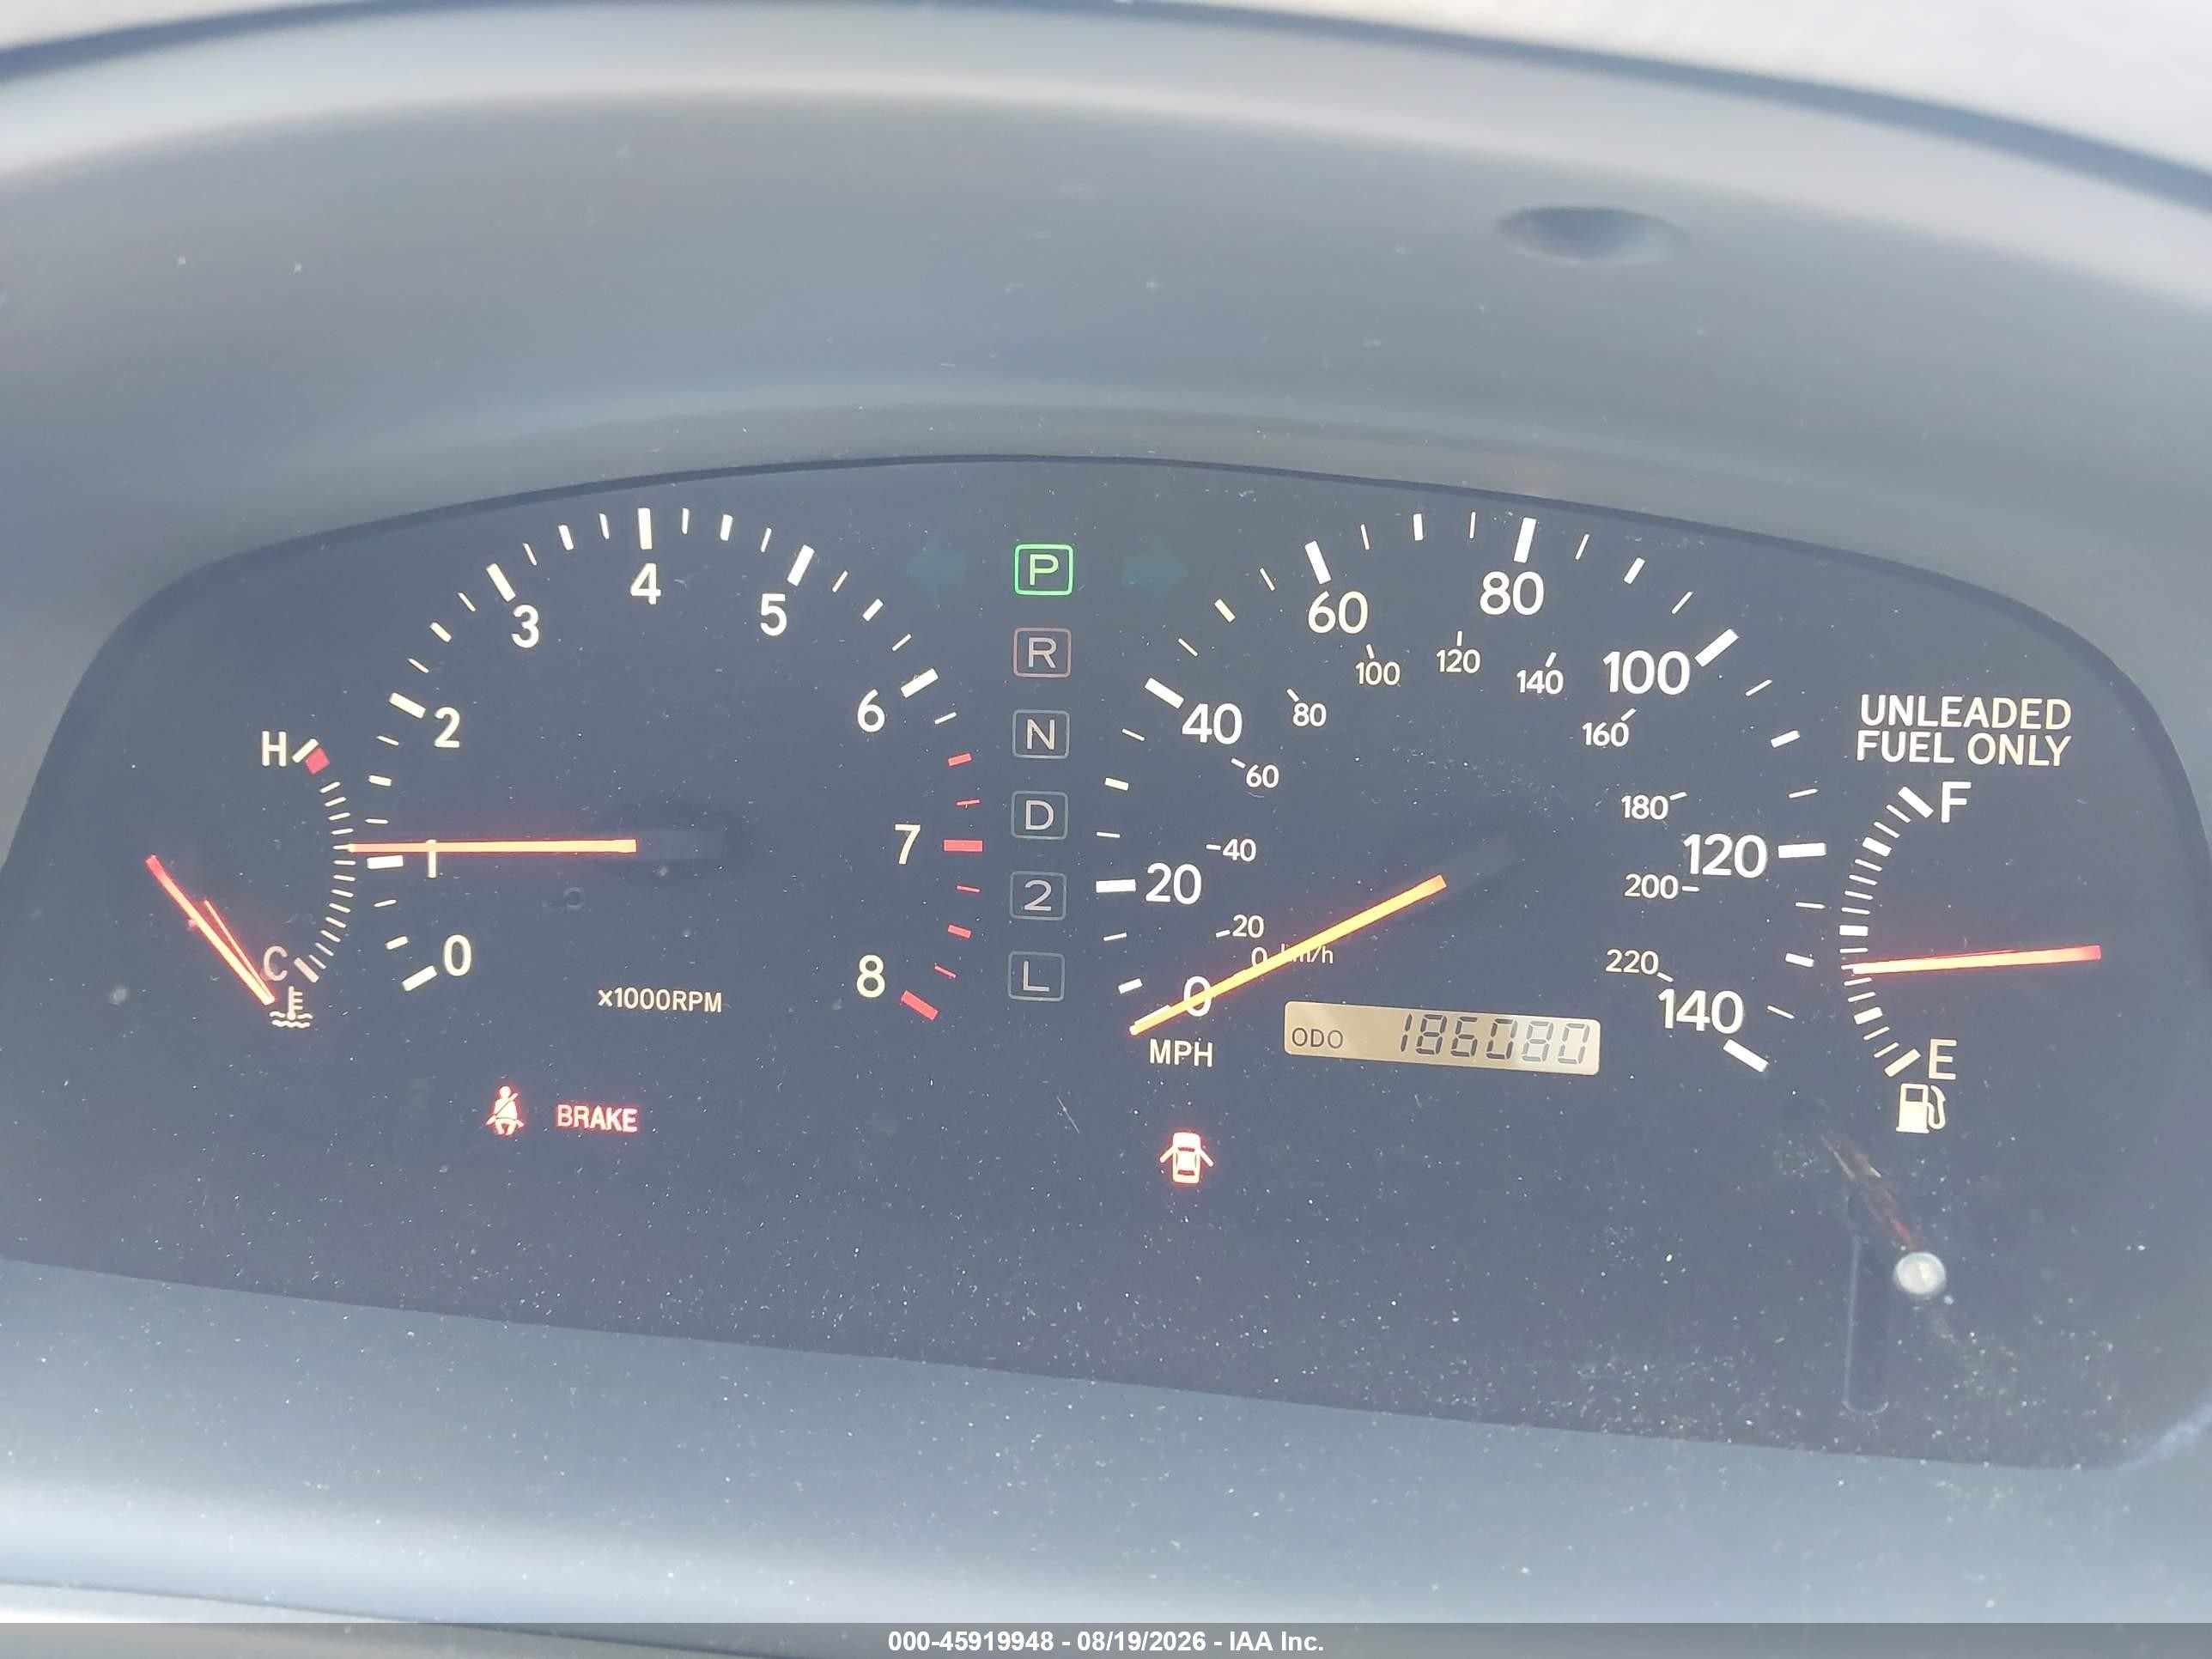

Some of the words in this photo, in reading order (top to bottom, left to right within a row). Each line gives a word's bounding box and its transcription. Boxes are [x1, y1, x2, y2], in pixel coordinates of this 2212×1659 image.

[630, 563, 661, 605] 4
[1029, 554, 1059, 586] P
[1480, 571, 1544, 615] 80
[512, 605, 538, 647] 3
[761, 593, 787, 635] 5
[1308, 591, 1369, 634] 60
[1028, 637, 1056, 668] R
[1437, 649, 1480, 673] 120
[1356, 661, 1401, 685] 100
[1516, 670, 1564, 694] 140
[1603, 650, 1690, 696] 100
[434, 707, 459, 748] 2
[858, 690, 887, 732] 6
[1182, 703, 1243, 744] 40
[1292, 702, 1327, 726] 80
[1862, 694, 2071, 730] UNLEADED
[262, 731, 286, 767] H
[1026, 720, 1055, 750] N
[1583, 723, 1629, 747] 160
[1857, 730, 1954, 763] FUEL
[1967, 732, 2071, 766] ONLY
[1246, 764, 1279, 788] 60
[1024, 800, 1054, 830] D
[1621, 794, 1668, 820] 180
[1942, 781, 1972, 823] F
[426, 839, 436, 878] 1
[895, 822, 921, 864] 7
[1223, 839, 1256, 861] 40
[1683, 834, 1767, 878] 120
[1022, 880, 1051, 911] 2
[1146, 863, 1201, 904] 20
[1625, 874, 1678, 899] 200
[1232, 915, 1264, 938] 20
[264, 945, 288, 981] C
[444, 935, 471, 976] 0
[1606, 949, 1658, 975] 220
[857, 955, 884, 997] 8
[1023, 962, 1049, 991] L
[1183, 975, 1212, 1017] 0
[1658, 988, 1745, 1034] 140
[1150, 1037, 1212, 1067] MPH
[1292, 1027, 1344, 1048] ODO
[1401, 1013, 1590, 1065] 186080
[1929, 1039, 1957, 1079] E
[556, 1105, 638, 1132] BRAKE
